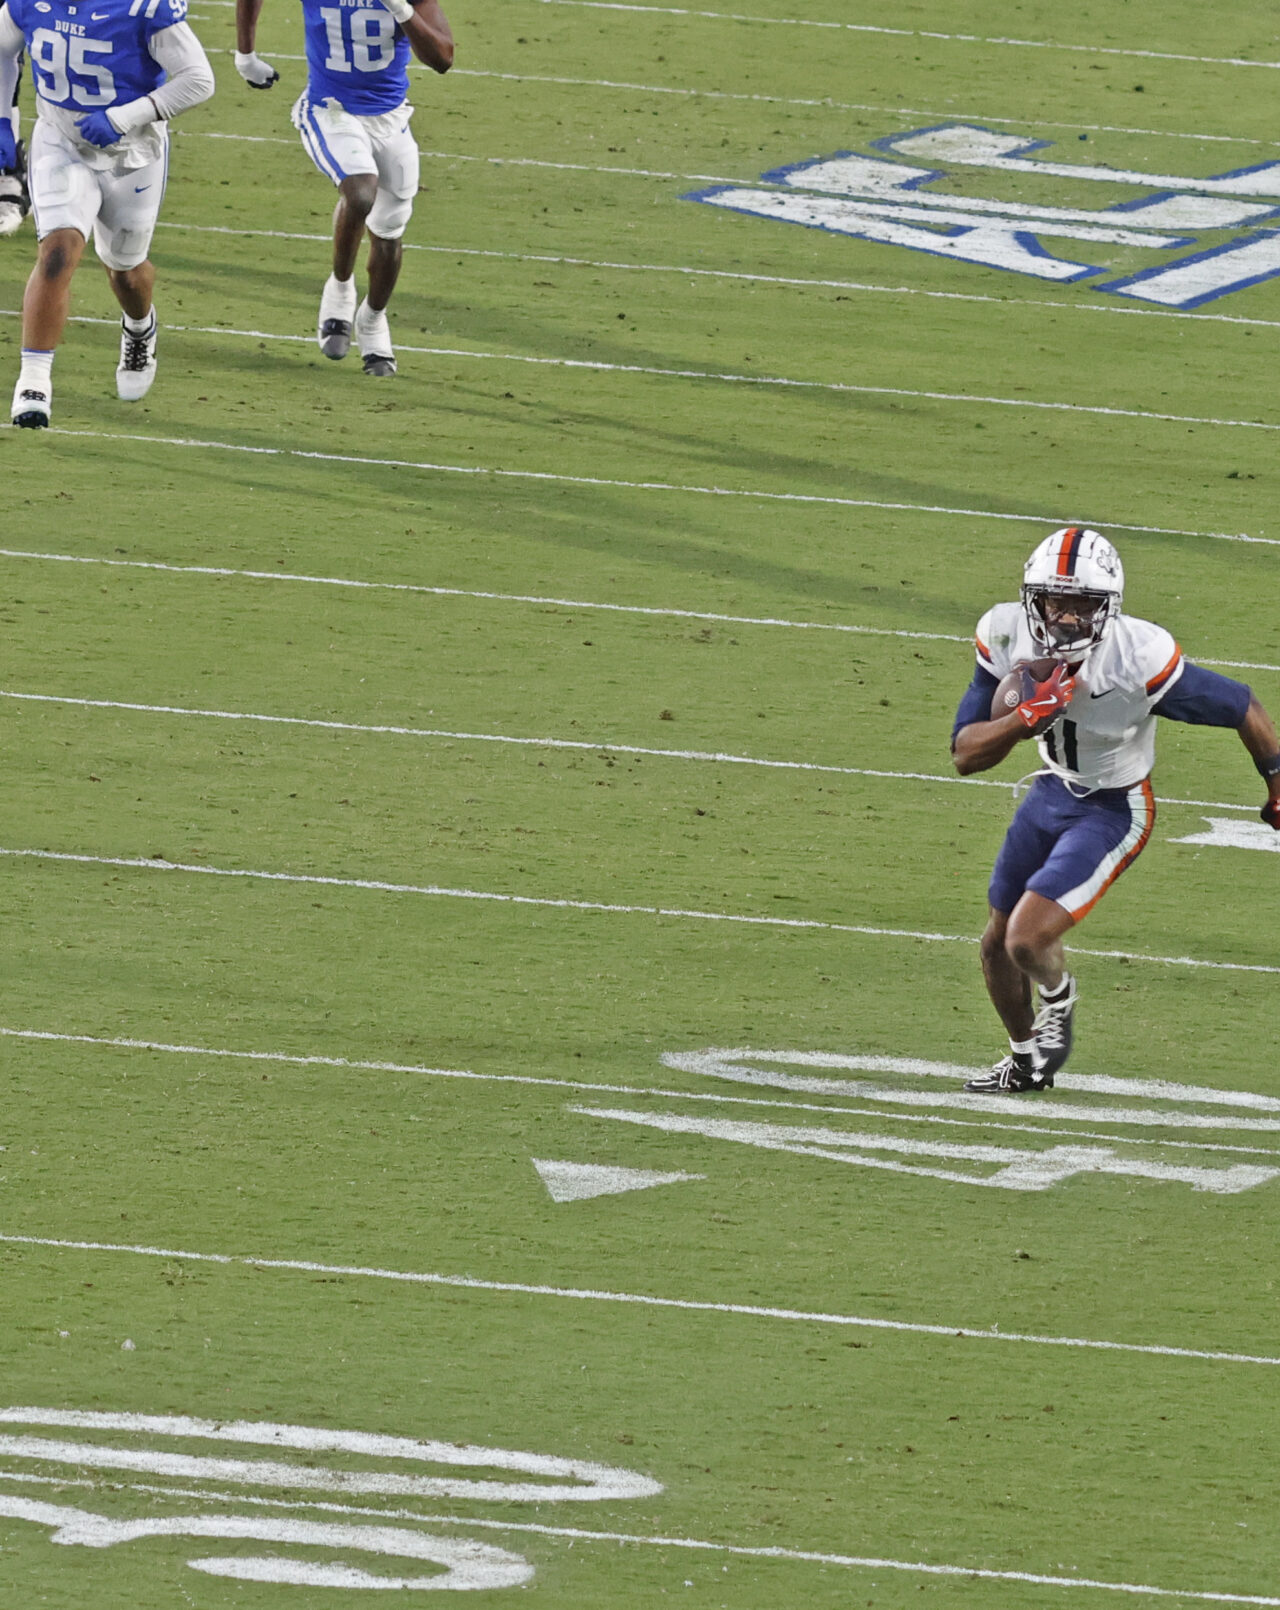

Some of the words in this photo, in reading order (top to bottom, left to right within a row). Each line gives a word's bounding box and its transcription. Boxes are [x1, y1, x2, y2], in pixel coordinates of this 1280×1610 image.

[339, 0, 374, 8] DUKE
[55, 20, 86, 37] DUKE
[320, 7, 395, 72] 18
[31, 27, 118, 106] 95
